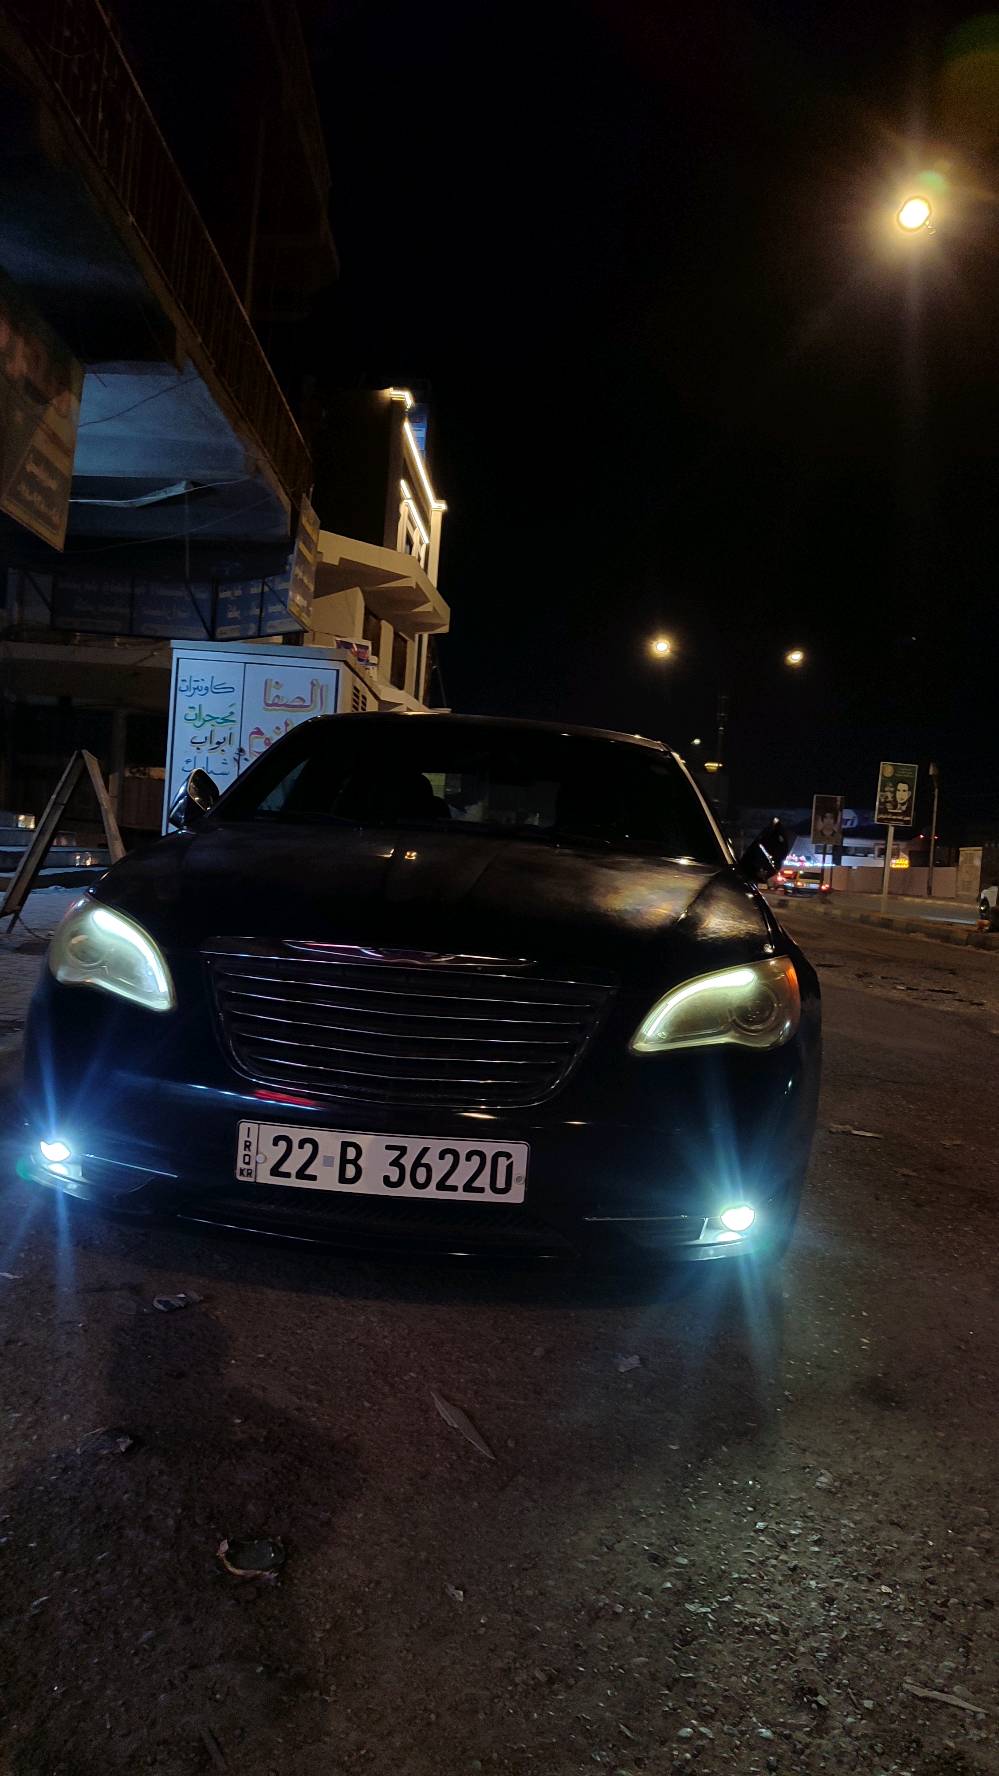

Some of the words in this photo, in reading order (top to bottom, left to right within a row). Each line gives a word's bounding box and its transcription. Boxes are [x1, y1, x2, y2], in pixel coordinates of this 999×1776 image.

[262, 677, 328, 713] الصفا
[239, 1167, 253, 1178] KR
[269, 1134, 319, 1182] 22
[338, 1140, 363, 1185] B
[382, 1143, 514, 1196] 36220
